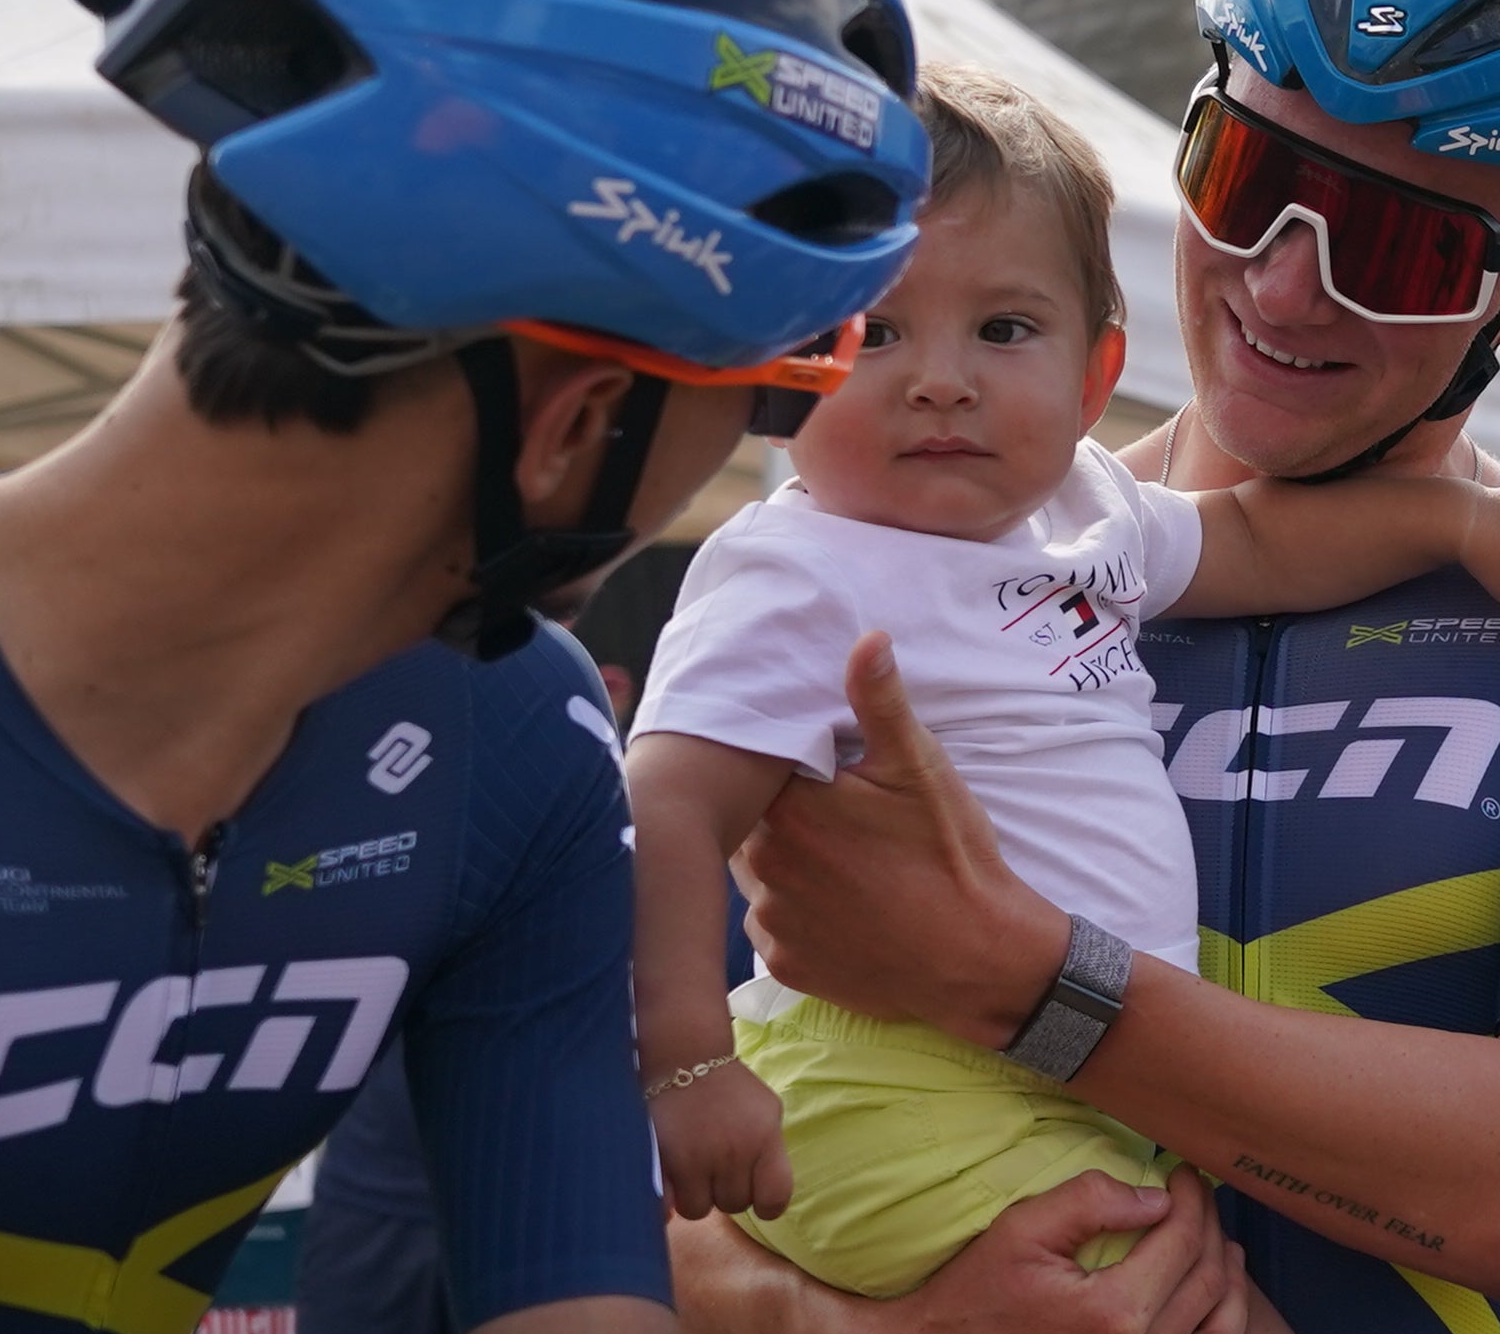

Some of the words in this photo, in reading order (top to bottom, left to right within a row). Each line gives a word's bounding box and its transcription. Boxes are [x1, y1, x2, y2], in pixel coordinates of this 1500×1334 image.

[770, 85, 875, 151] UNITED
[775, 52, 882, 121] SPEED
[566, 176, 733, 296] Spiuk
[317, 854, 411, 887] UNITED
[318, 831, 417, 868] SPEED
[1233, 1154, 1309, 1195] FAITH
[1314, 1189, 1380, 1226] OVER
[1383, 1217, 1445, 1252] FEAR
